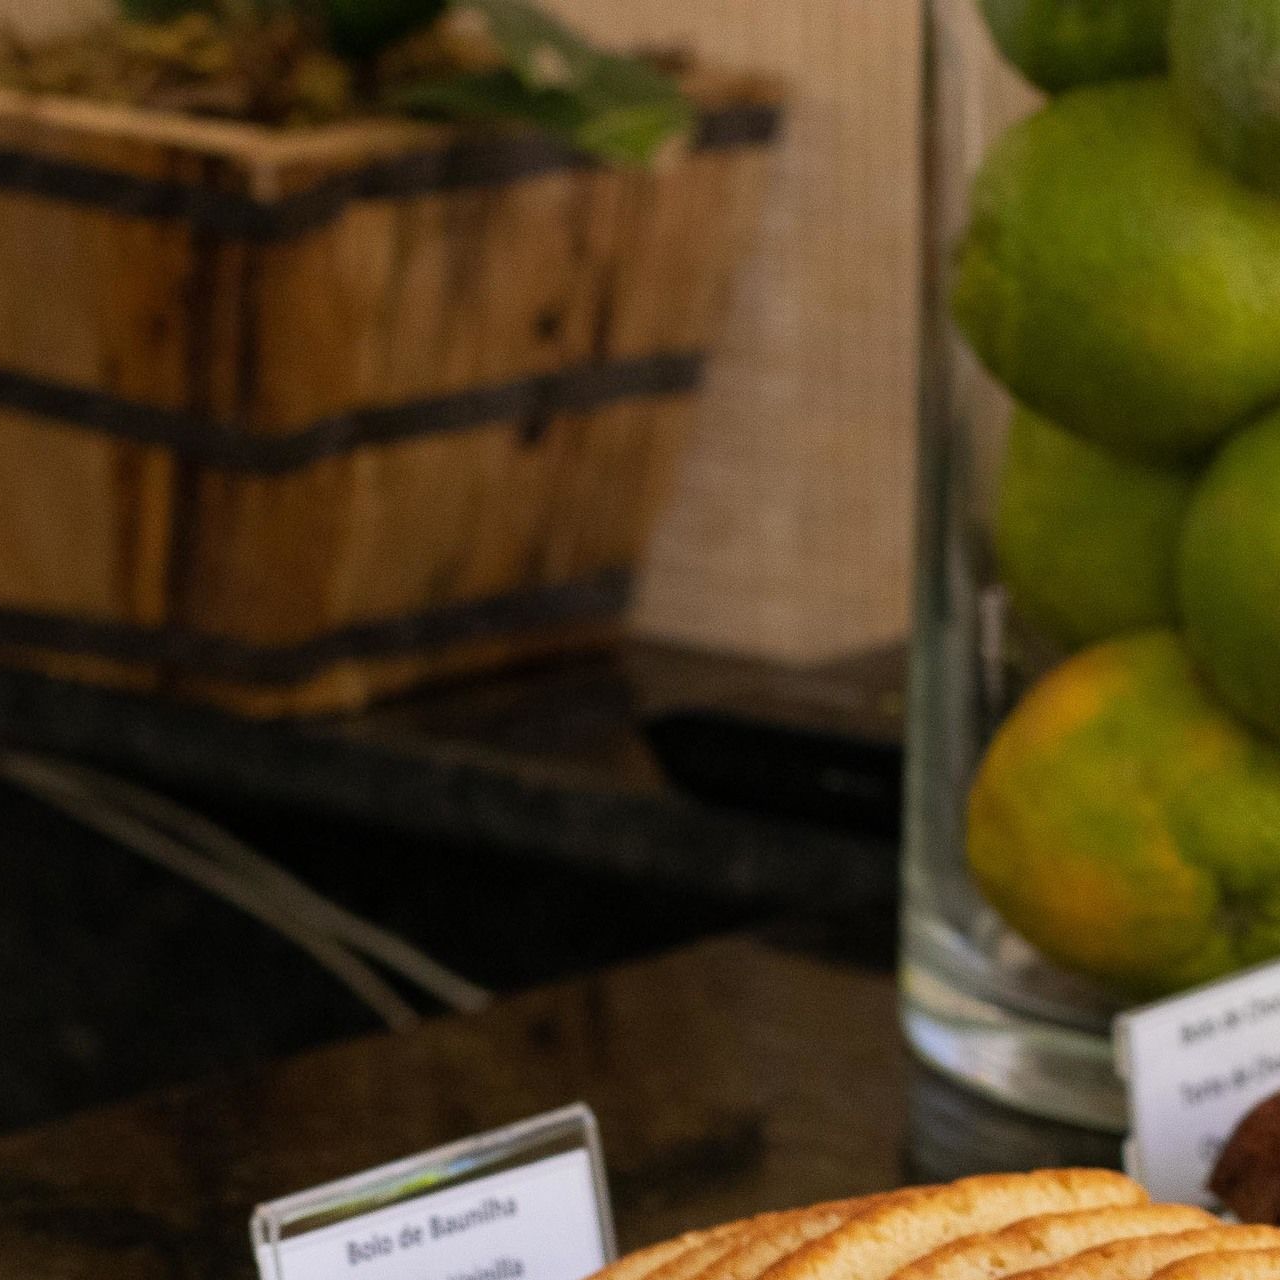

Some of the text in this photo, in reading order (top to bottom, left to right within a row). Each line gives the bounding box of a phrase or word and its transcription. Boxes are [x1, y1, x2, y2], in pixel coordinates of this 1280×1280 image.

[346, 1194, 518, 1266] Bolo de Baunilha
